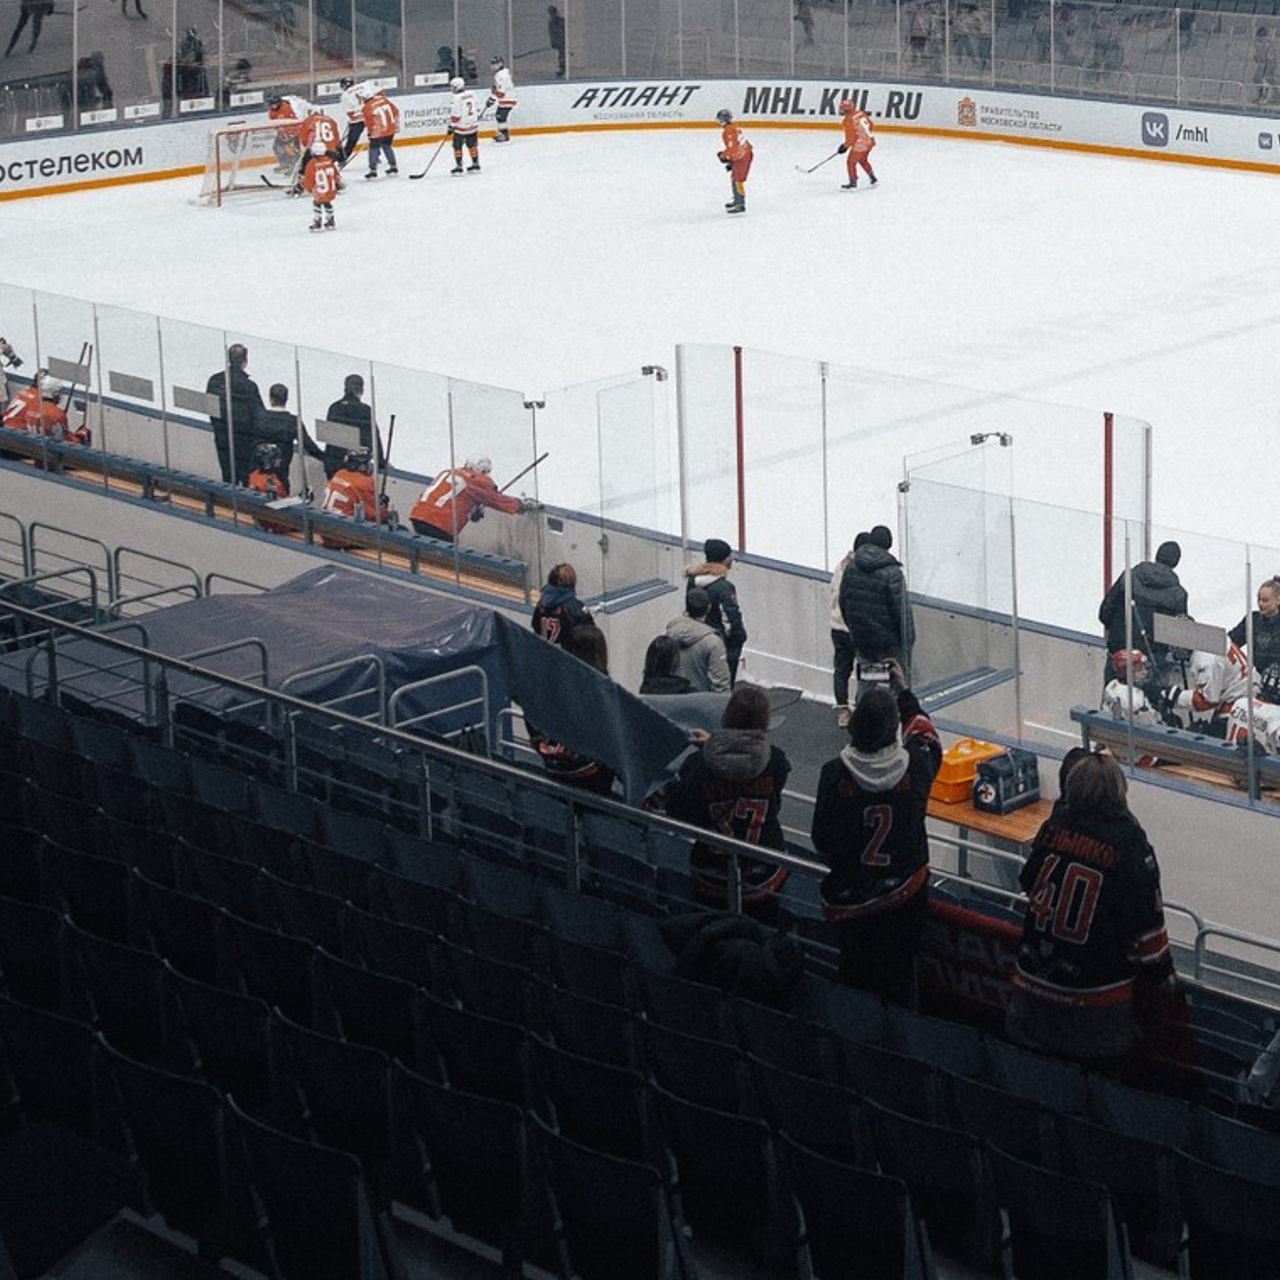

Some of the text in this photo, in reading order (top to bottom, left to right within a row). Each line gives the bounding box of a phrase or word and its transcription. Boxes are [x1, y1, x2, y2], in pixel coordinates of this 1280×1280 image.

[572, 85, 701, 109] АТЛАНТ
[742, 86, 923, 120] MHL.KHL.RU
[404, 117, 451, 130] МОСКОВСК
[1175, 124, 1209, 143] /mhl
[860, 803, 893, 867] 2
[1030, 852, 1104, 945] 40
